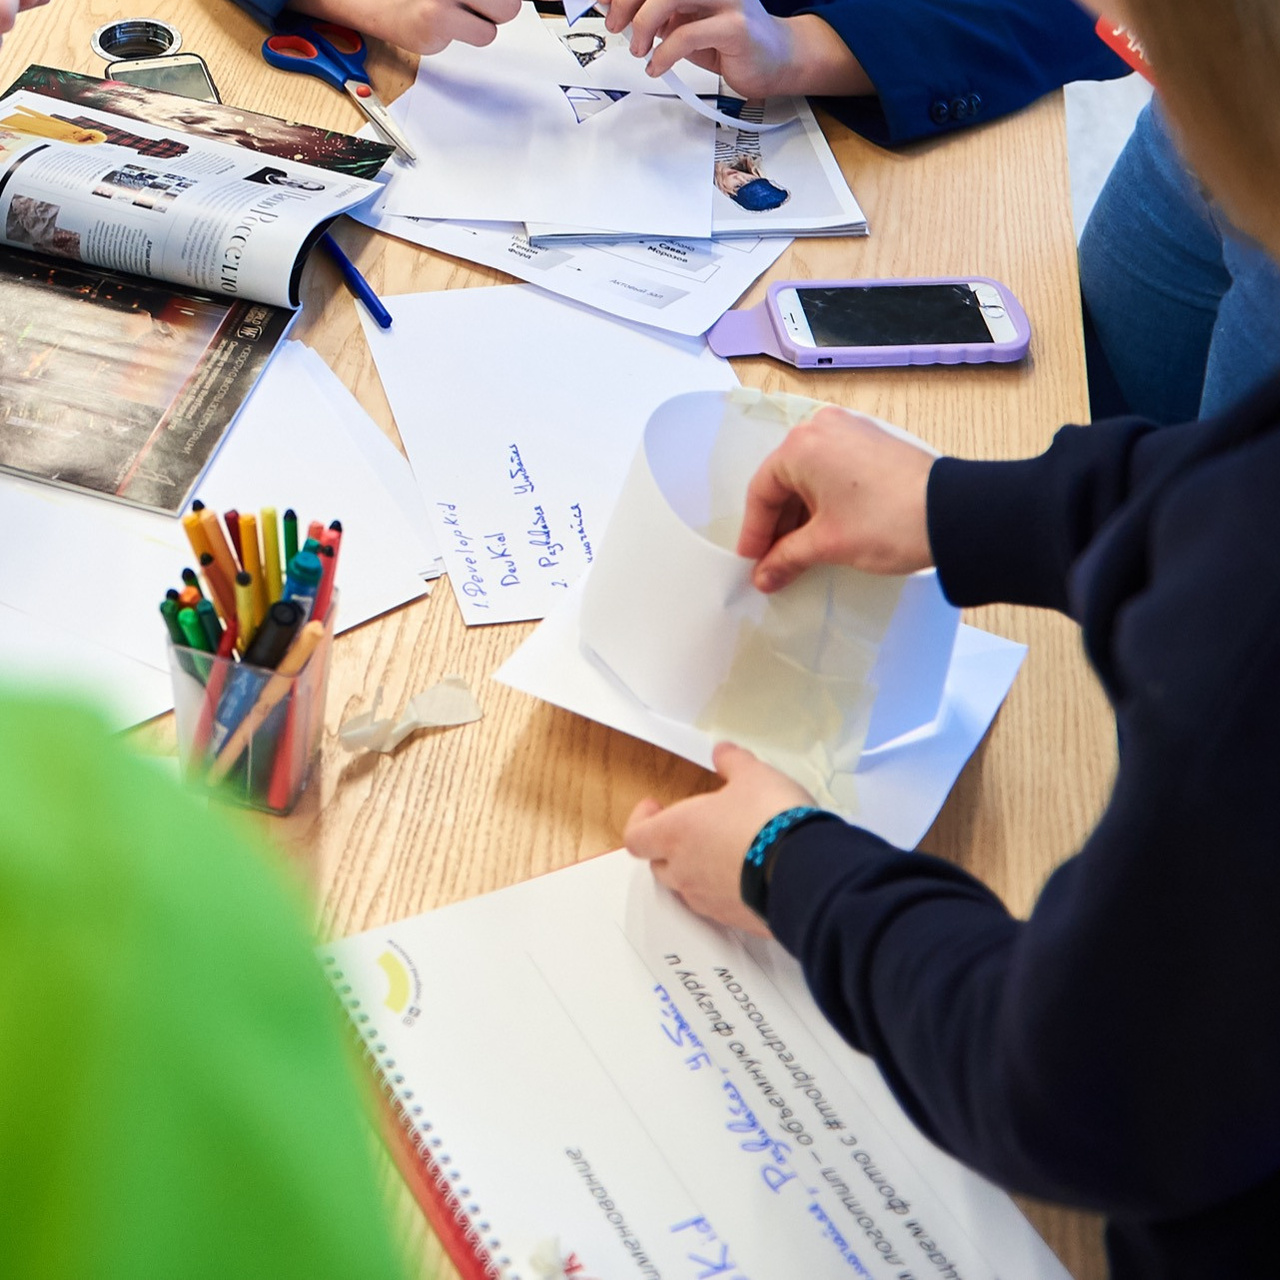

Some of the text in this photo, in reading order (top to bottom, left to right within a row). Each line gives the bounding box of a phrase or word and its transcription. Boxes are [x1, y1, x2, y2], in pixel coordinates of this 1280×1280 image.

[648, 246, 688, 263] Морозов
[675, 969, 735, 1037] фигуру
[713, 966, 847, 1131] #molpredmoscow
[729, 1041, 813, 1146] объемную
[821, 1167, 906, 1266] логотип
[852, 1151, 911, 1216] фото
